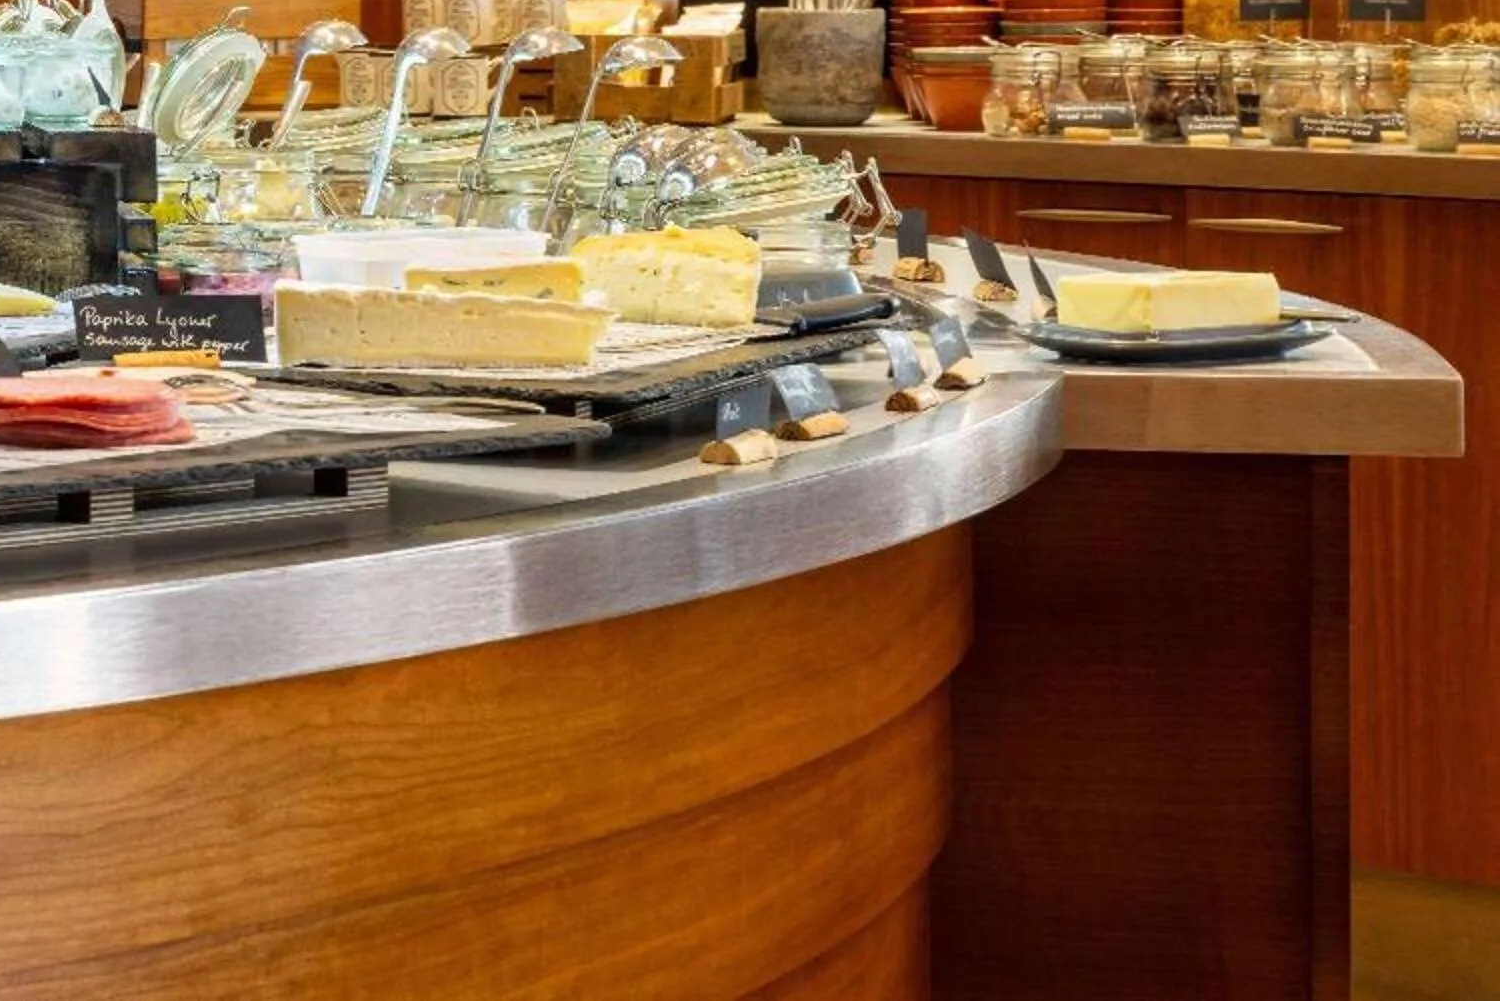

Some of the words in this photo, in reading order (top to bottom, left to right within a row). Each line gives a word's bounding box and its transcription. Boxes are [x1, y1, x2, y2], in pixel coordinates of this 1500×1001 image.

[79, 304, 149, 332] Paprika
[155, 307, 218, 337] Lyoner
[161, 333, 197, 349] with
[201, 339, 251, 354] pepper
